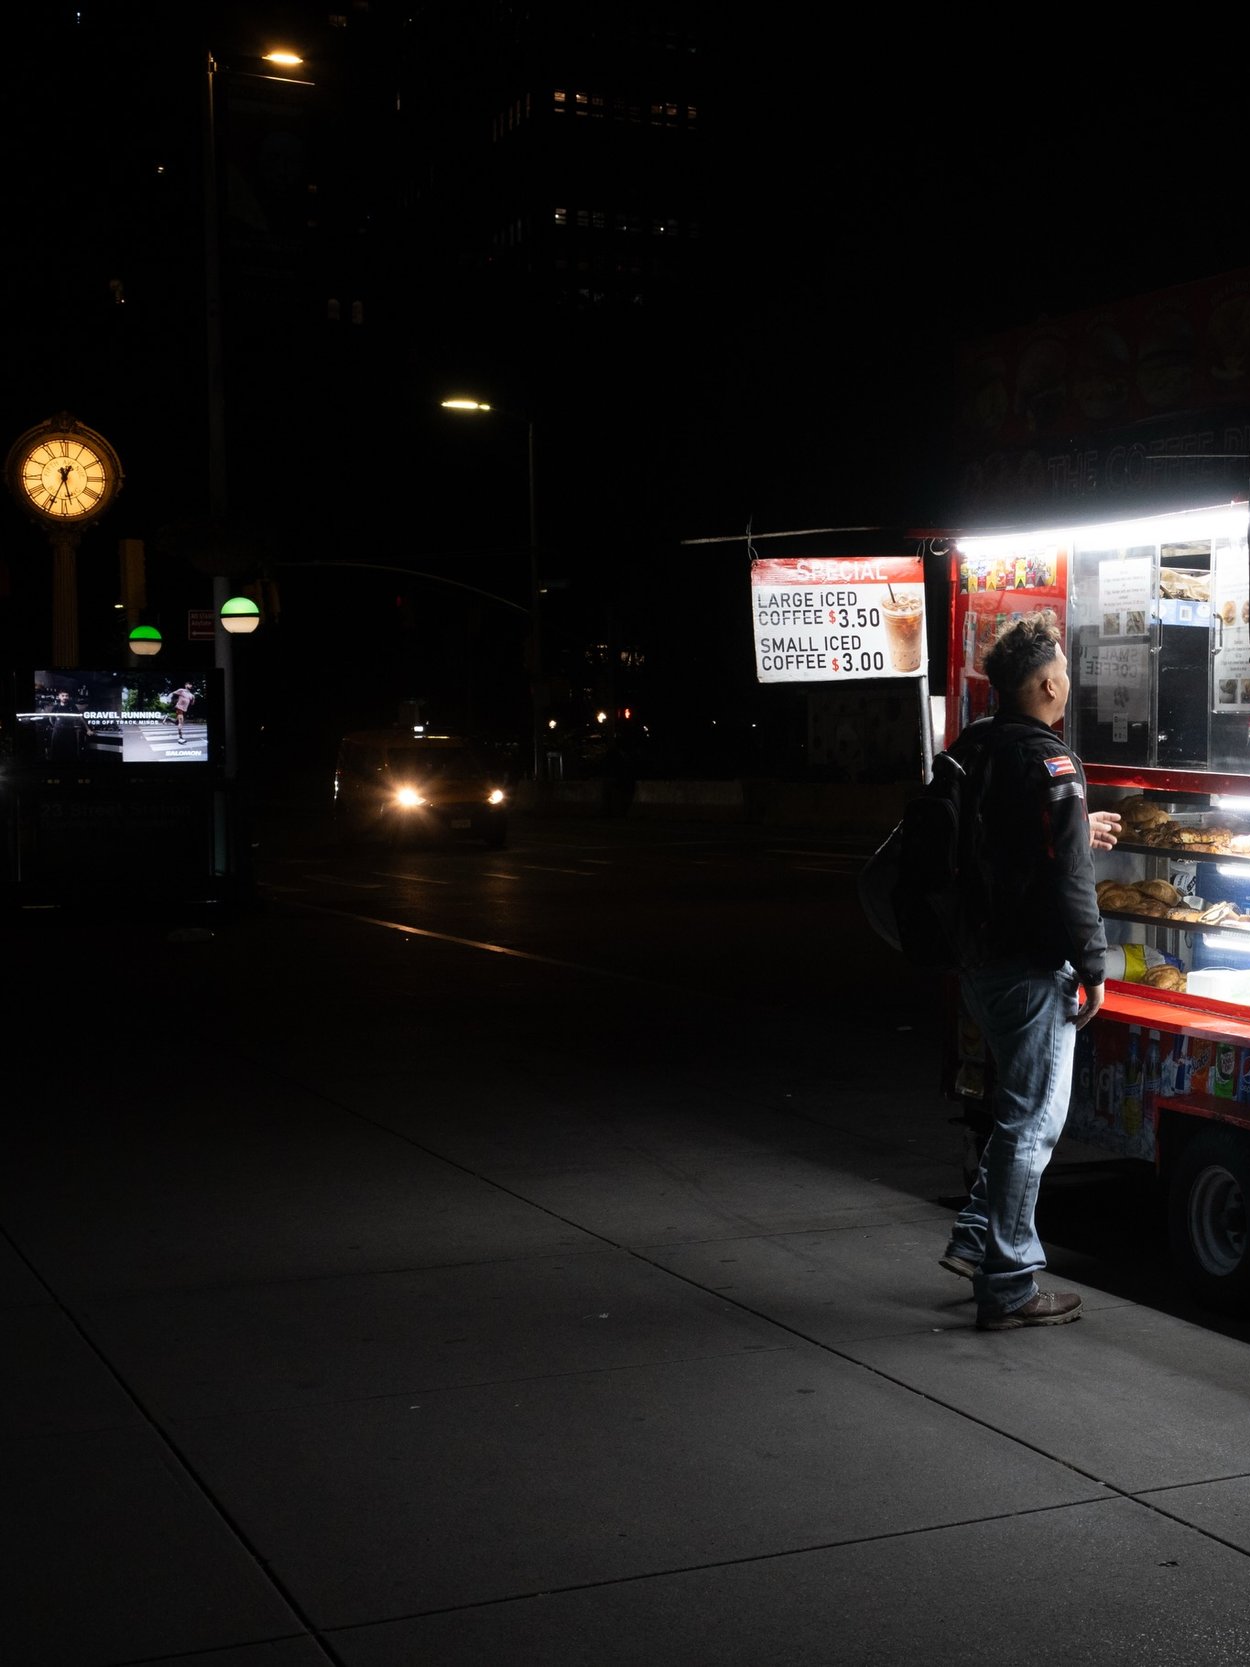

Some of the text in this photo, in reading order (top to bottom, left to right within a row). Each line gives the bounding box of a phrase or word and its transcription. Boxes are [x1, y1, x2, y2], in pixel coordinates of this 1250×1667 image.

[797, 560, 888, 581] SPECIAL
[758, 591, 857, 608] LARGE ICED
[758, 608, 880, 628] COFFEE $3.50
[760, 635, 862, 653] SMALL ICED
[762, 651, 884, 672] COFFEE $3.00
[83, 711, 162, 719] GRAVEL RUNNING
